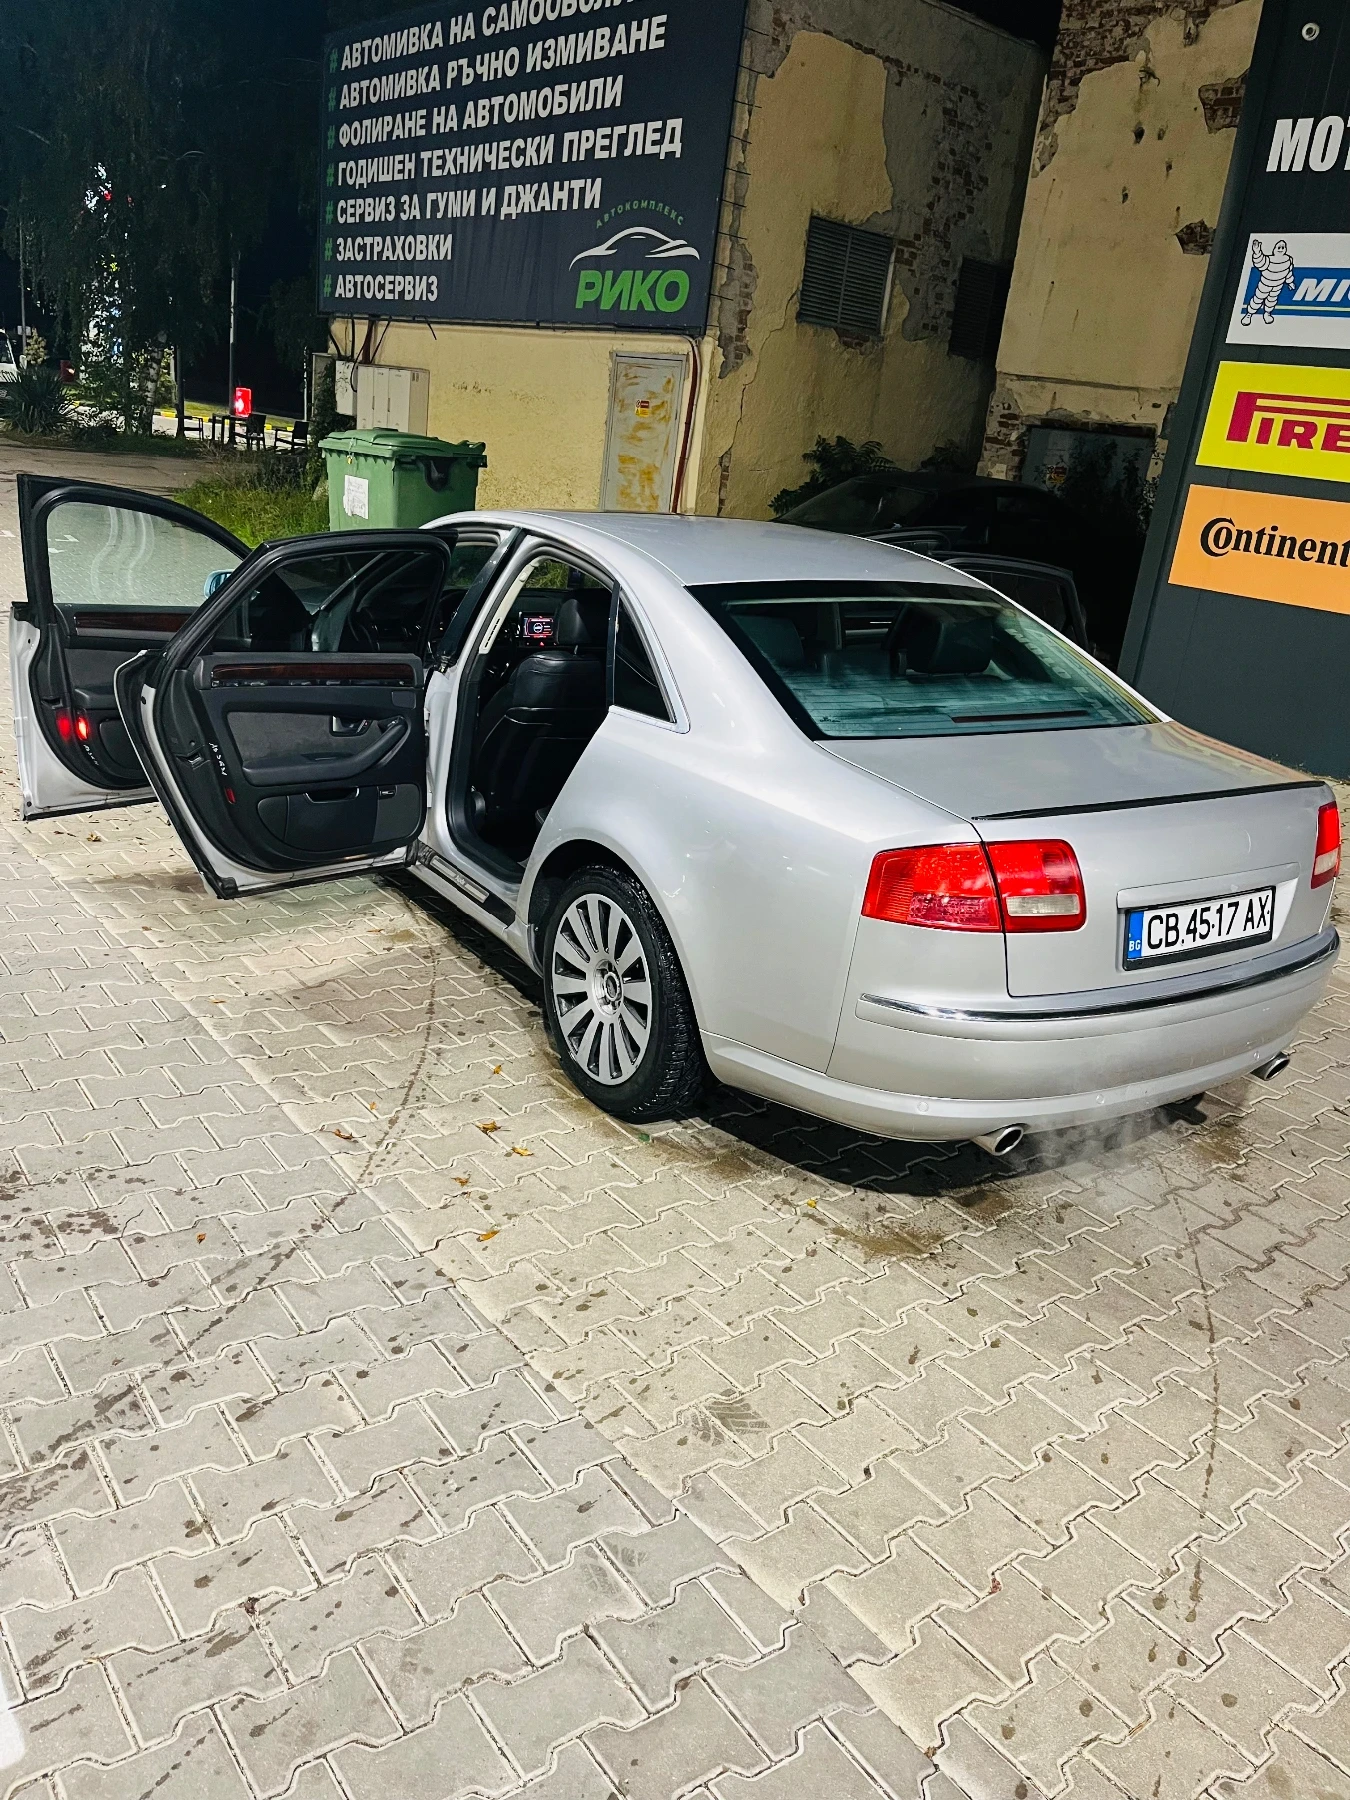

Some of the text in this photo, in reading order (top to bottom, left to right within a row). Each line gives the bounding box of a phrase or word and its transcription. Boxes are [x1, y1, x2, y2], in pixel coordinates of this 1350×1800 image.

[339, 65, 440, 110] АВТОМИВКА
[446, 47, 520, 89] РЪЧНО
[525, 14, 667, 73] ИЗМИВАНЕ
[341, 21, 443, 70] АВТОМИВКА
[449, 12, 475, 45] НА
[339, 109, 426, 147] ФОЛИРАНЕ
[432, 104, 458, 134] НА
[462, 74, 623, 129] АВТОМОБИЛИ
[338, 153, 415, 189] ГОДИШЕН
[420, 134, 554, 177] ТЕХНИЧЕСКИ
[561, 118, 682, 162] ПРЕГЛЕД
[1266, 115, 1350, 172] MO
[337, 195, 396, 224] СЕРВИЗ
[400, 194, 420, 221] ЗА
[426, 189, 476, 219] ГУМИ
[481, 187, 496, 216] И
[500, 178, 602, 220] ДЖАНТИ
[596, 199, 684, 229] АВТОКОМПЛЕКС
[336, 234, 452, 261] ЗАСТРАХОВКИ
[334, 274, 438, 301] АВТОСЕРВИЗ
[575, 269, 690, 313] РИКО
[1128, 939, 1141, 952] BG
